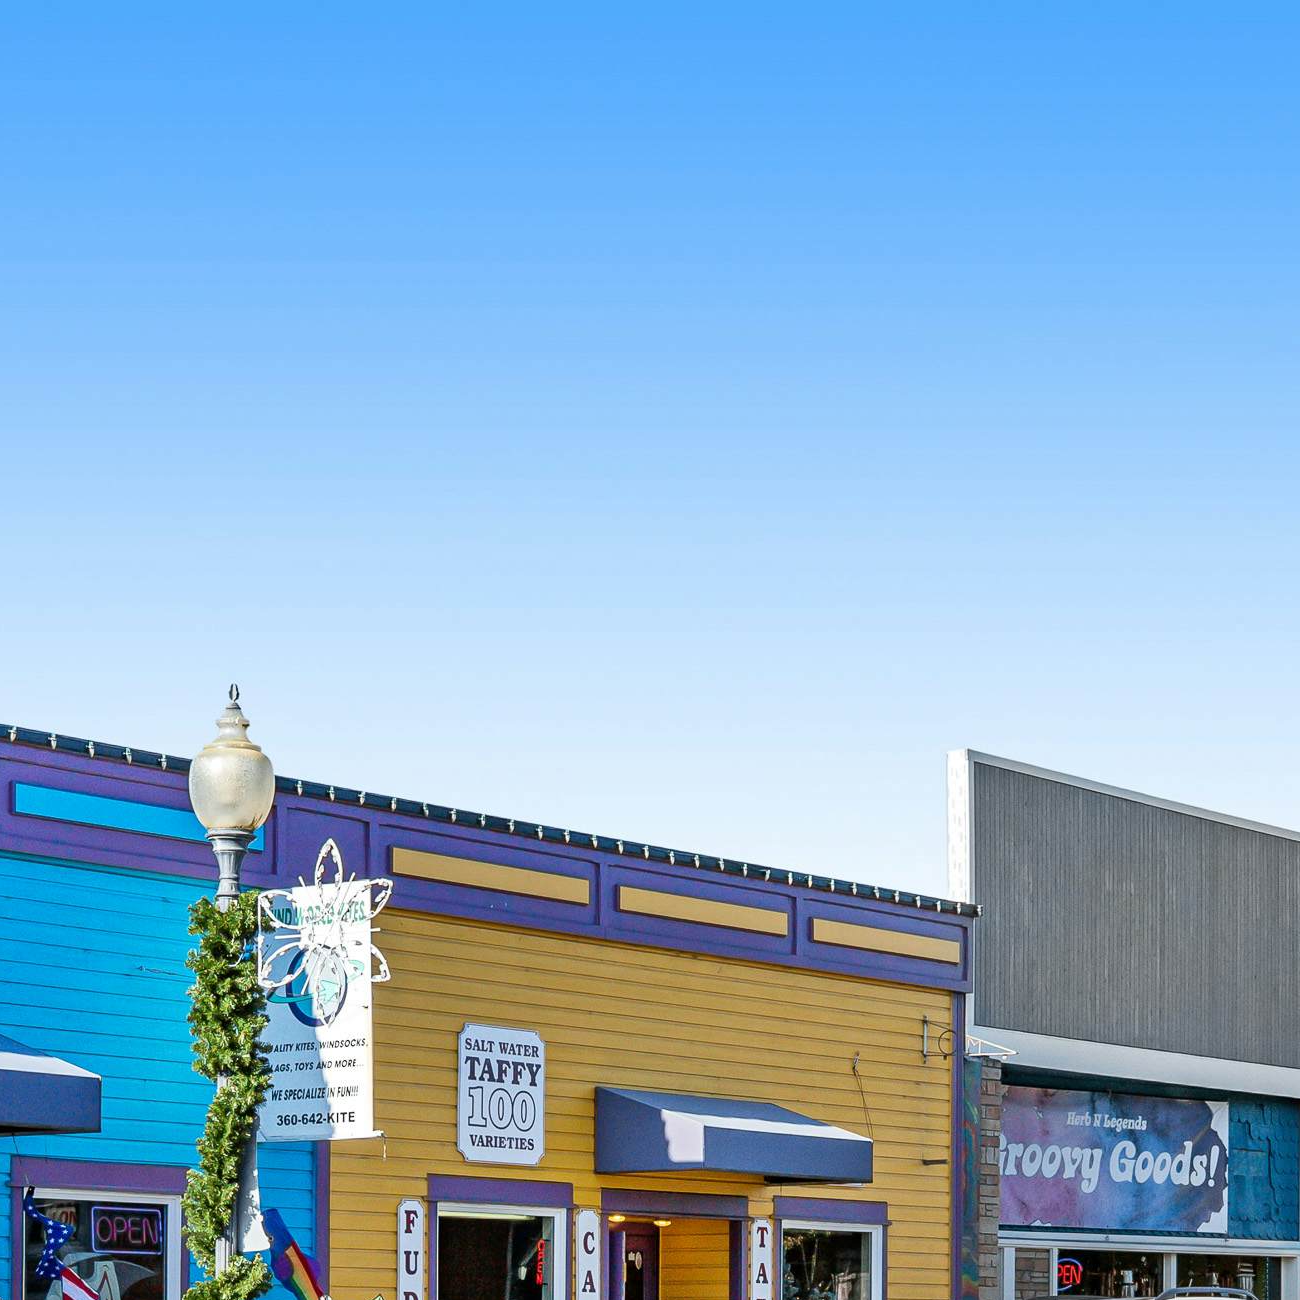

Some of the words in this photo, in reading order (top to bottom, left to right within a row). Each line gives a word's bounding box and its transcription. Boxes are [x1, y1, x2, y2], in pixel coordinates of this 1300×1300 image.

[273, 1043, 295, 1053] ALITY
[295, 1042, 318, 1052] KITES,
[465, 1037, 495, 1053] SALT
[499, 1041, 540, 1058] WATER
[295, 1061, 314, 1072] TOYS
[316, 1060, 333, 1070] AND
[464, 1056, 542, 1087] TAFFY
[271, 1089, 283, 1102] WE
[283, 1087, 326, 1101] SPECIALIZE
[327, 1087, 335, 1098] IN
[277, 1111, 356, 1126] 360-642-KITE
[468, 1085, 536, 1132] 100
[1067, 1111, 1091, 1126] Herb
[1103, 1114, 1148, 1132] Legends
[469, 1134, 535, 1151] VARIETIES
[1109, 1140, 1220, 1187] Goods!
[96, 1216, 158, 1244] OPEN
[1057, 1264, 1081, 1285] PEN
